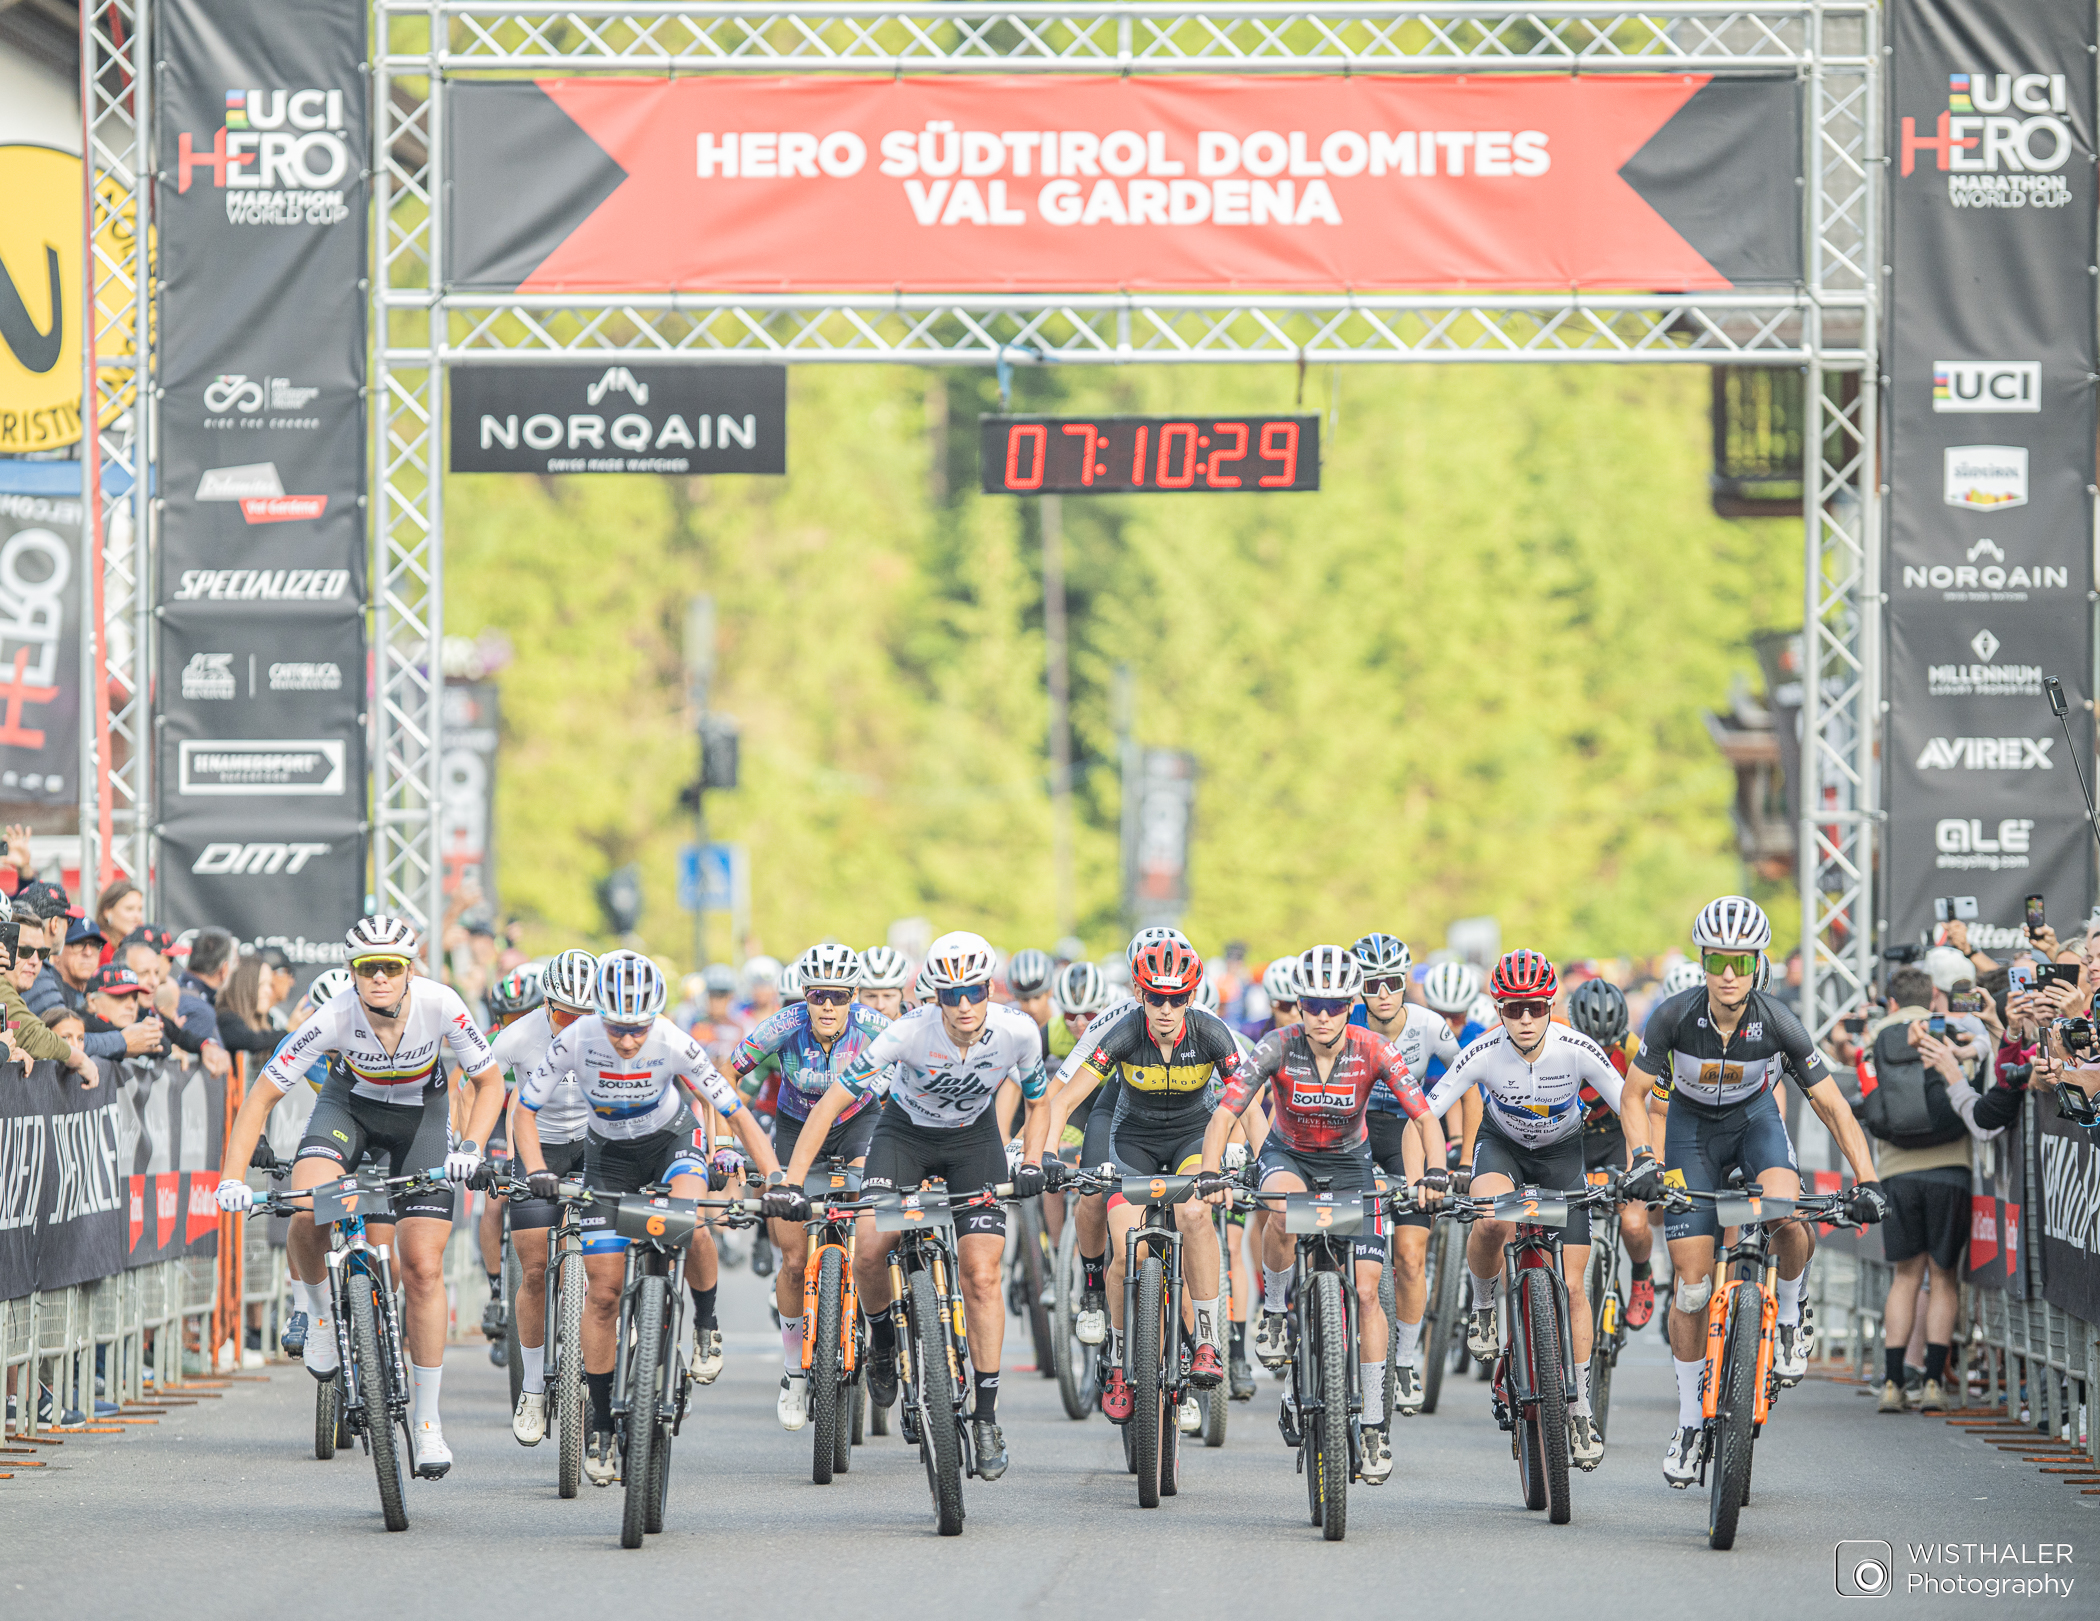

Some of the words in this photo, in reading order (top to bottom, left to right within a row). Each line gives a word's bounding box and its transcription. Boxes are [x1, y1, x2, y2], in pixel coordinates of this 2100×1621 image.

[1970, 73, 2067, 113] UCI
[247, 89, 343, 130] UCI
[697, 131, 868, 178] HERO
[879, 120, 1184, 178] SÜDTIROL
[1198, 130, 1551, 178] DOLOMITES
[1901, 110, 2073, 179] HERO
[178, 125, 347, 194] HERO
[1948, 175, 2067, 191] MARATHON
[226, 191, 343, 208] MARATHON
[904, 180, 1026, 226] VAL
[1037, 180, 1343, 226] GARDENA
[1949, 190, 2026, 208] WORLD
[2029, 190, 2073, 208] CUP
[226, 205, 301, 225] WORLD
[306, 205, 348, 225] CUP
[1954, 371, 2031, 401] UCI
[2, 402, 81, 442] RISTI
[480, 413, 758, 452] NORQAIN
[1004, 420, 1300, 490] 07:10:29
[174, 569, 350, 601] SPECIALIZED
[1903, 565, 2068, 589] NORQAIN
[1928, 664, 2042, 685] MILLENNIUM
[1916, 737, 2054, 770] AVIREX
[192, 843, 326, 874] DMT
[1089, 1002, 1130, 1033] SCOTT
[291, 1026, 322, 1055] KENDA
[1559, 1035, 1611, 1069] ALLEBIKE
[1456, 1037, 1501, 1073] ALLEBIKE
[598, 1079, 652, 1089] SOUDAL
[1152, 1075, 1204, 1086] STROBY
[938, 1096, 976, 1111] 7C
[1293, 1093, 1354, 1107] SOUDAL
[830, 1176, 845, 1188] 5
[1149, 1178, 1167, 1198] 9
[341, 1195, 359, 1212] 7
[406, 1205, 450, 1213] LOOK
[1522, 1200, 1539, 1217] 2
[646, 1215, 666, 1236] 6
[969, 1215, 992, 1229] 7C
[1315, 1206, 1333, 1227] 3
